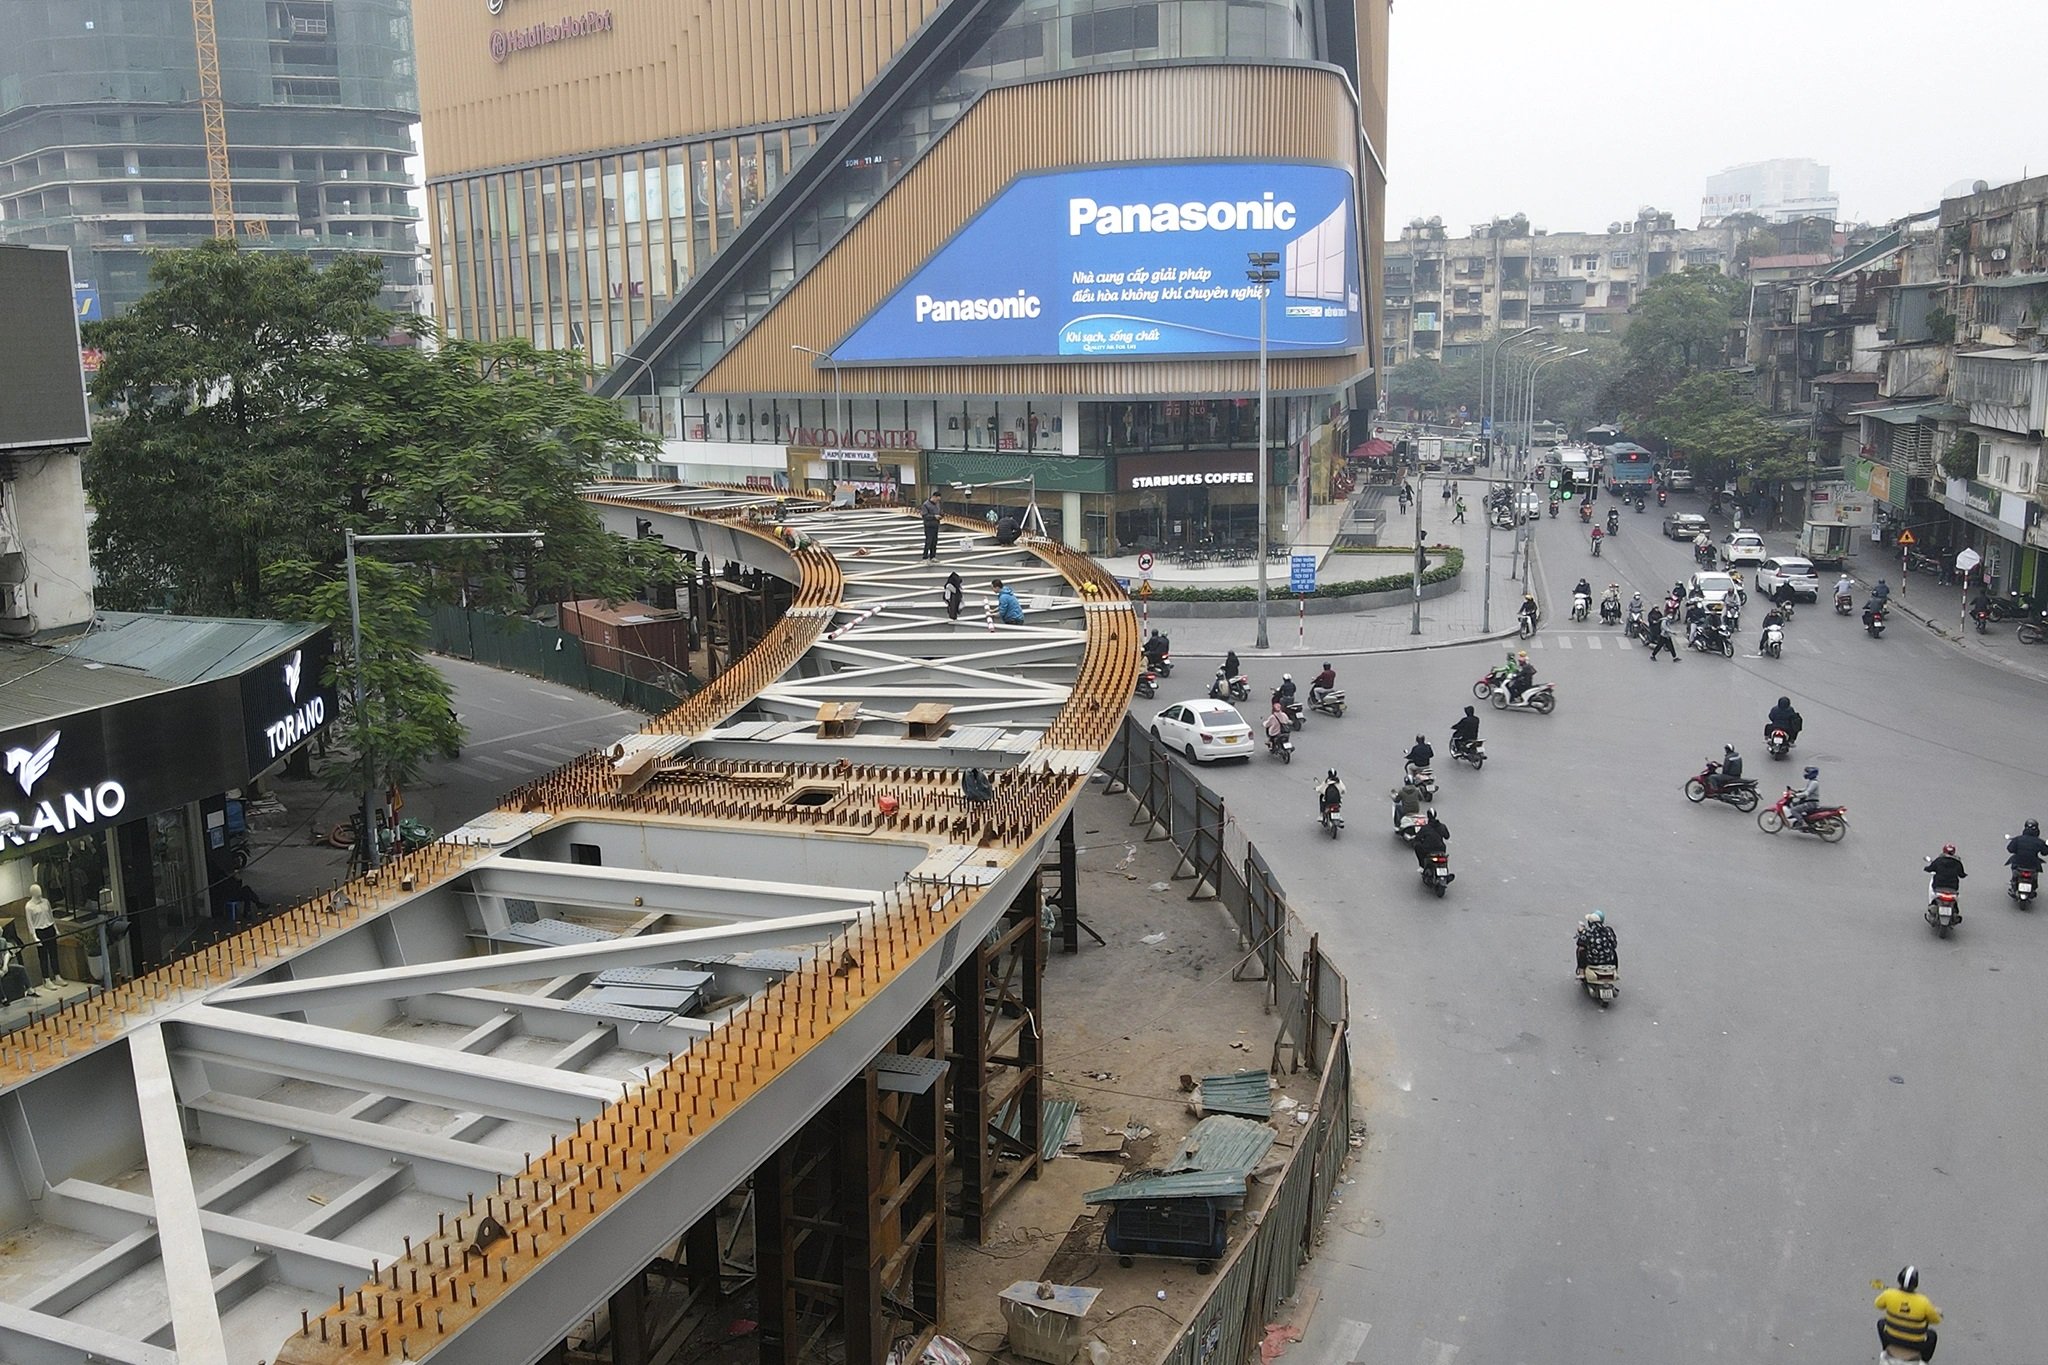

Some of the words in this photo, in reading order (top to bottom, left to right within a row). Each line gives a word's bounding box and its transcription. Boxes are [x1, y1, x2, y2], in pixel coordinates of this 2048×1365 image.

[1069, 192, 1297, 236] Panasonic
[1072, 270, 1095, 284] Nhà
[1096, 271, 1125, 286] cung
[1126, 266, 1150, 285] cấp
[1150, 267, 1178, 285] giải
[1178, 266, 1213, 283] pháp
[1072, 287, 1095, 303] điều
[1096, 288, 1119, 302] hòa
[1120, 287, 1160, 305] không
[1161, 286, 1184, 300] khí
[1184, 285, 1229, 302] chuyên
[915, 289, 1041, 323] Panasonic
[1065, 331, 1081, 343] Khí
[1108, 329, 1134, 344] sống
[1135, 327, 1161, 341] chất
[786, 427, 854, 447] VINCOM
[854, 429, 919, 449] CENTER
[1132, 473, 1203, 489] STARBUCKS
[1204, 472, 1254, 484] COFFEE
[265, 696, 324, 758] TORANO
